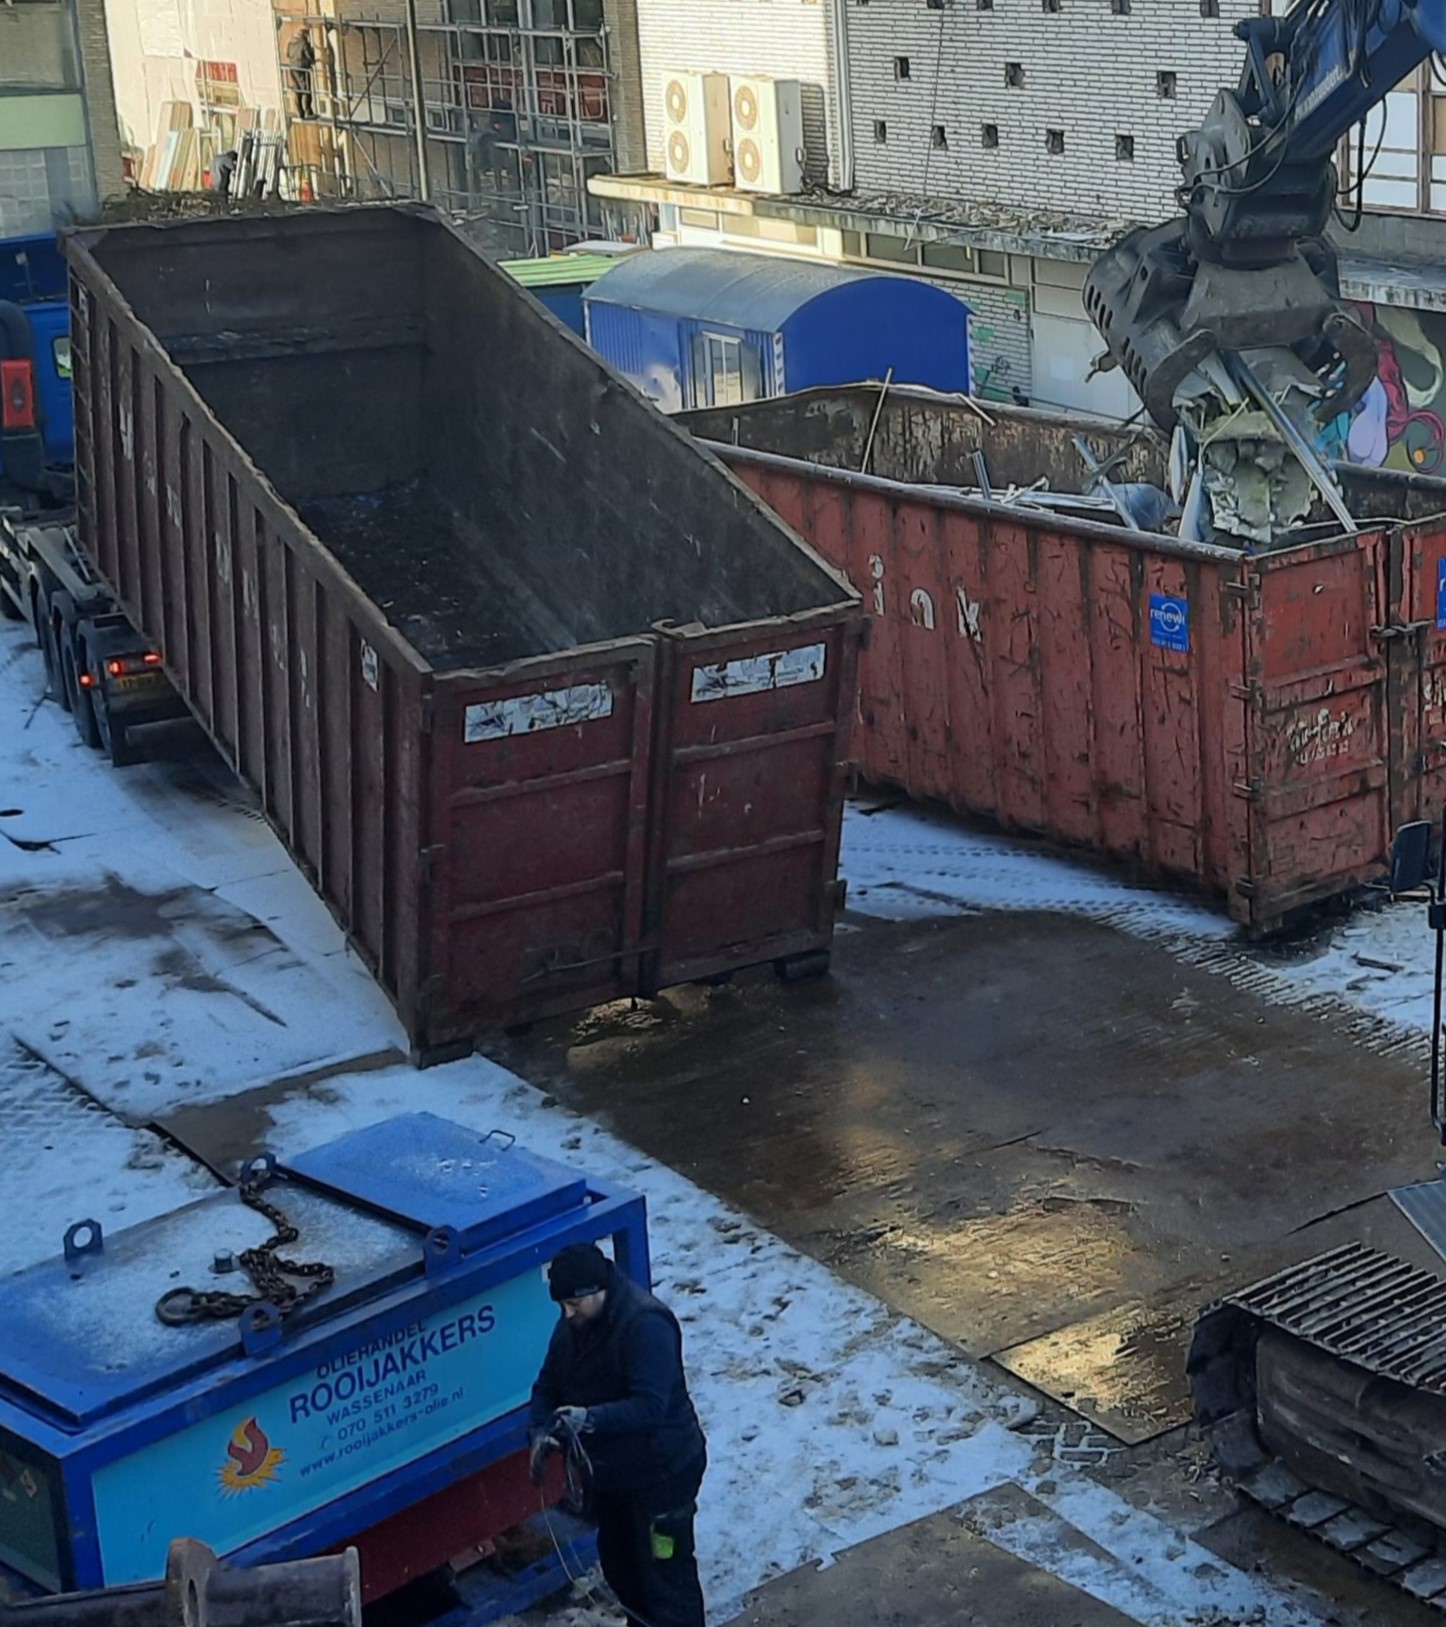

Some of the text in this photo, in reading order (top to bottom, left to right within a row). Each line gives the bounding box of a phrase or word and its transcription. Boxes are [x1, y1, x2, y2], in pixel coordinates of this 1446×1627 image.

[1150, 608, 1185, 626] renewi
[289, 1305, 496, 1424] ROOIJAKKERS
[316, 1320, 428, 1379] OLIEHANDEL
[326, 1369, 427, 1426] WASSENAAR
[338, 1383, 439, 1441] 070 511 3279
[300, 1386, 464, 1477] www.rooijakkers-olie.nl
